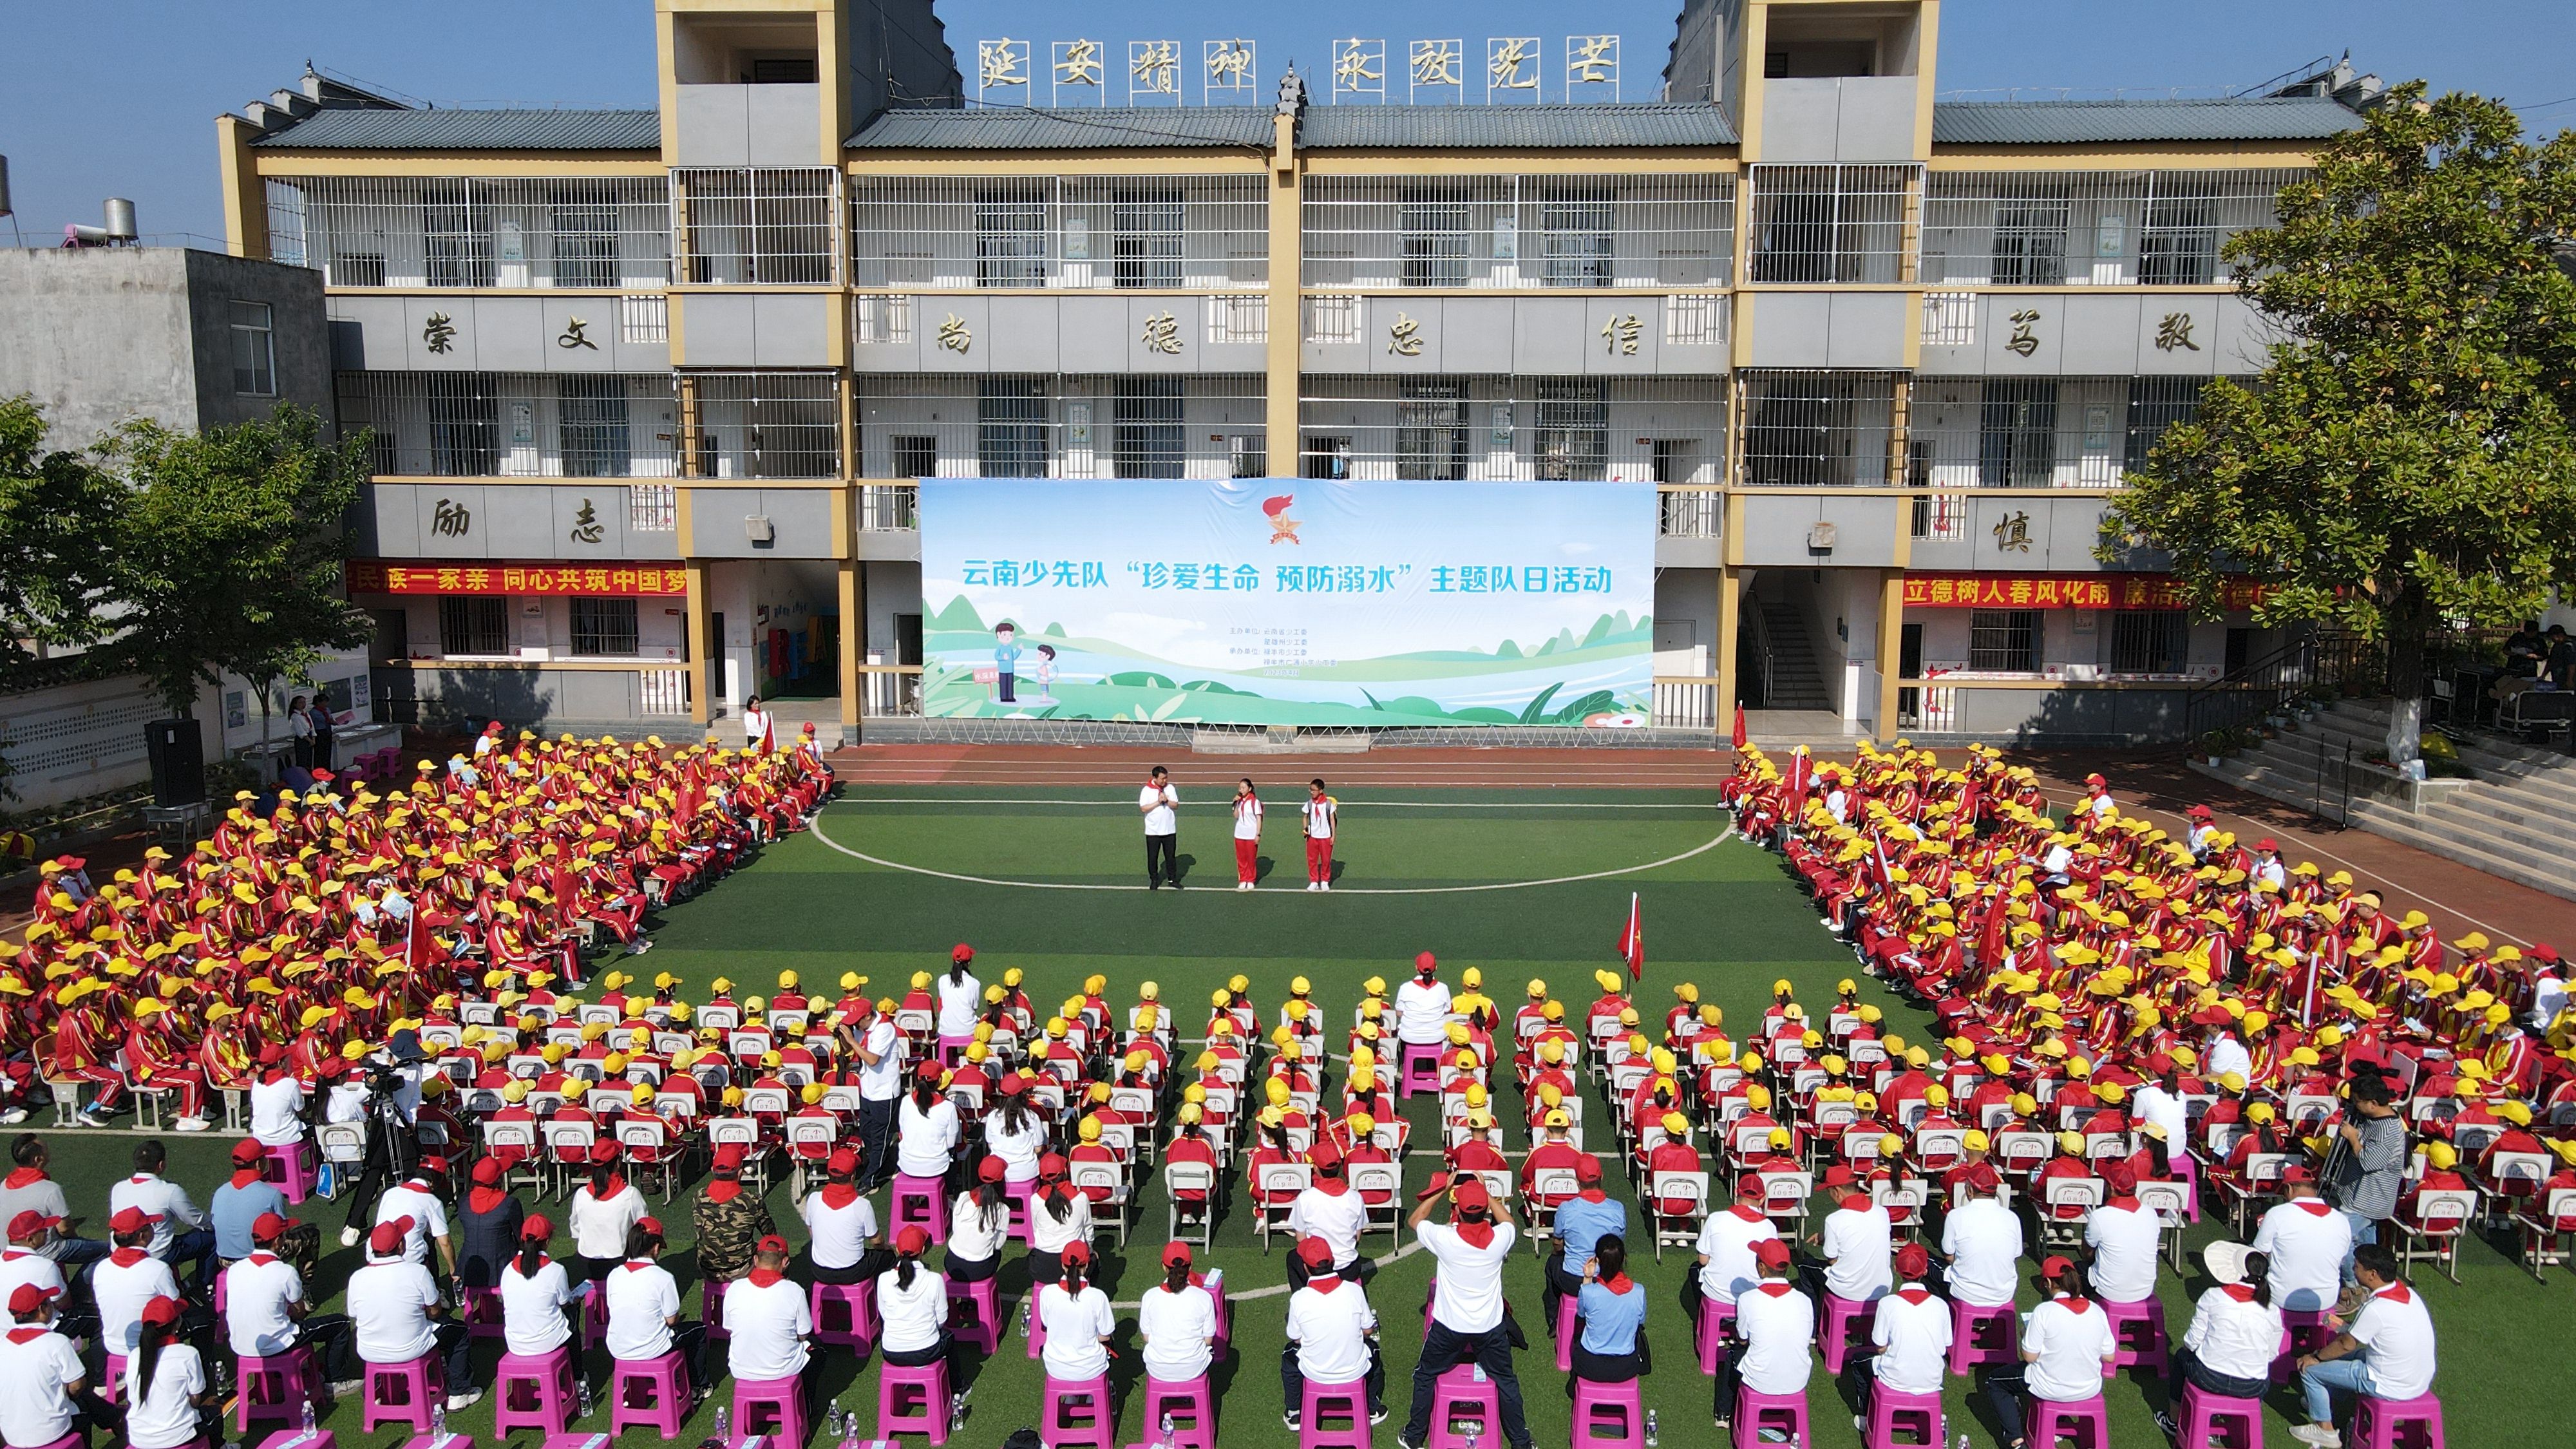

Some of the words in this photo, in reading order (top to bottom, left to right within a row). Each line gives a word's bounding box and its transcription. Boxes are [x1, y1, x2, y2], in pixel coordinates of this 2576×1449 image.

[981, 37, 1251, 94] 延安精神
[1337, 34, 1615, 91] 永放光芒
[346, 565, 489, 590] 民族一家亲
[504, 567, 687, 592] 同心共筑中国梦
[1904, 578, 2110, 605] 立德树人春风化雨
